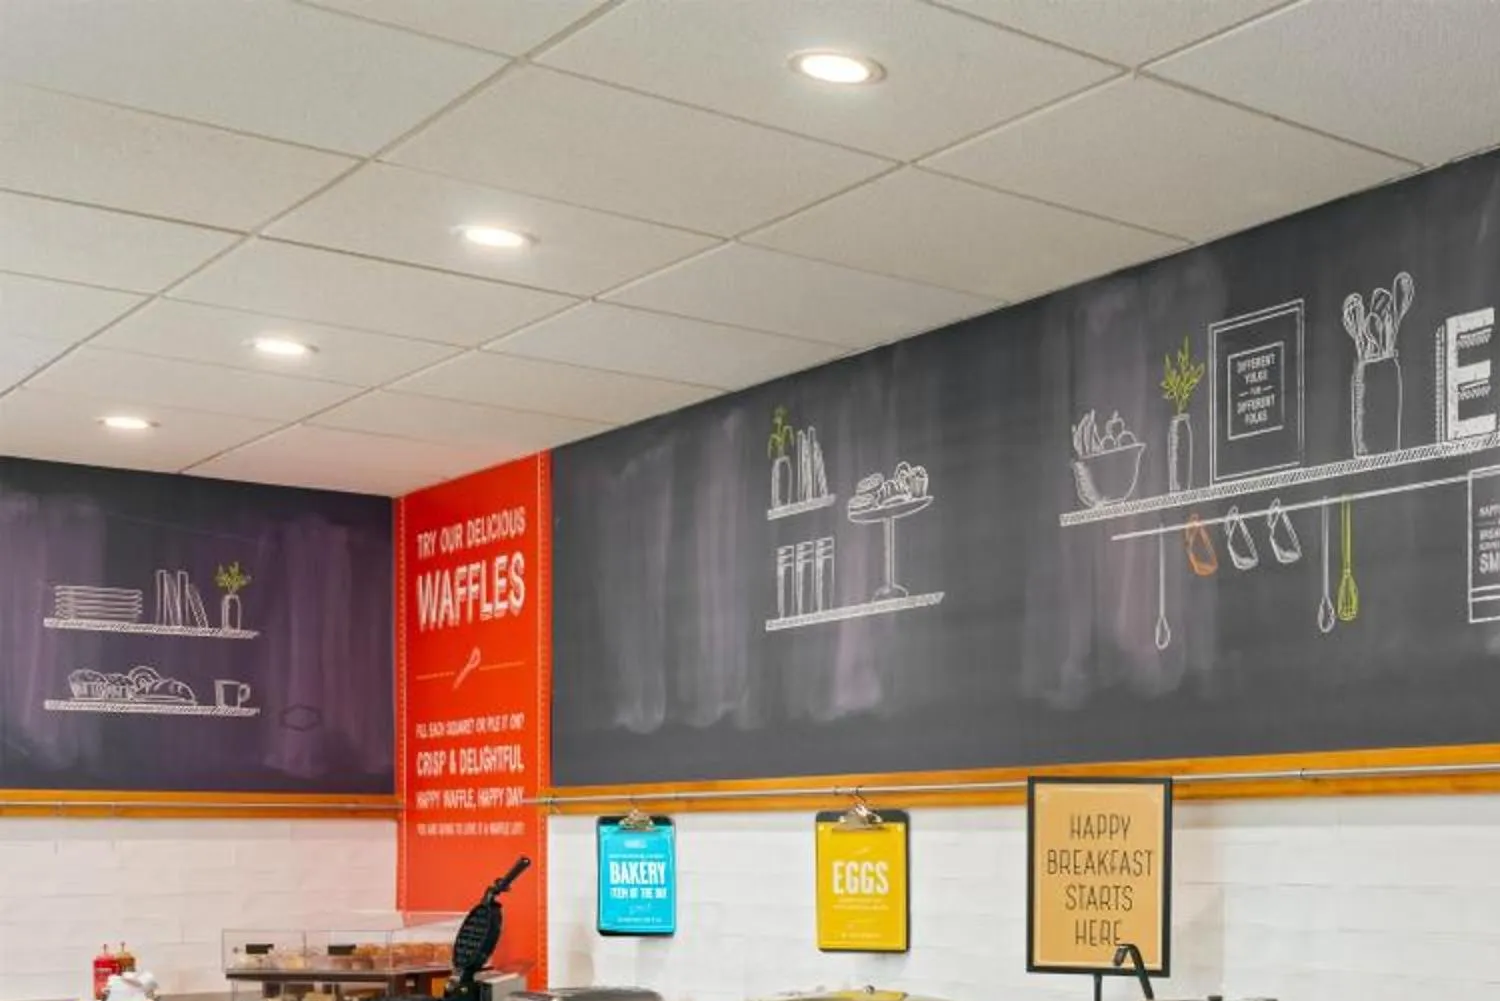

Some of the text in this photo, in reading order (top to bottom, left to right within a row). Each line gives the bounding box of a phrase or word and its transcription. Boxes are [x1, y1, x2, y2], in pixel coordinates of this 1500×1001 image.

[1237, 353, 1276, 374] DIFFERENT
[1237, 393, 1275, 415] DIFFERENT
[417, 506, 526, 560] TRY OUR DELICIOUS
[417, 551, 526, 632] WAFFLES
[417, 744, 525, 777] CRISP & DELIGHTFUL
[416, 790, 441, 810] HAPPY
[477, 786, 505, 808] HAPPY
[1069, 813, 1131, 841] HAPPY
[609, 861, 667, 885] BAKERY
[1047, 849, 1153, 877] BREAKFAST
[832, 860, 890, 896] EGGS
[1064, 884, 1134, 912] STARTS
[1074, 919, 1123, 947] HERE
